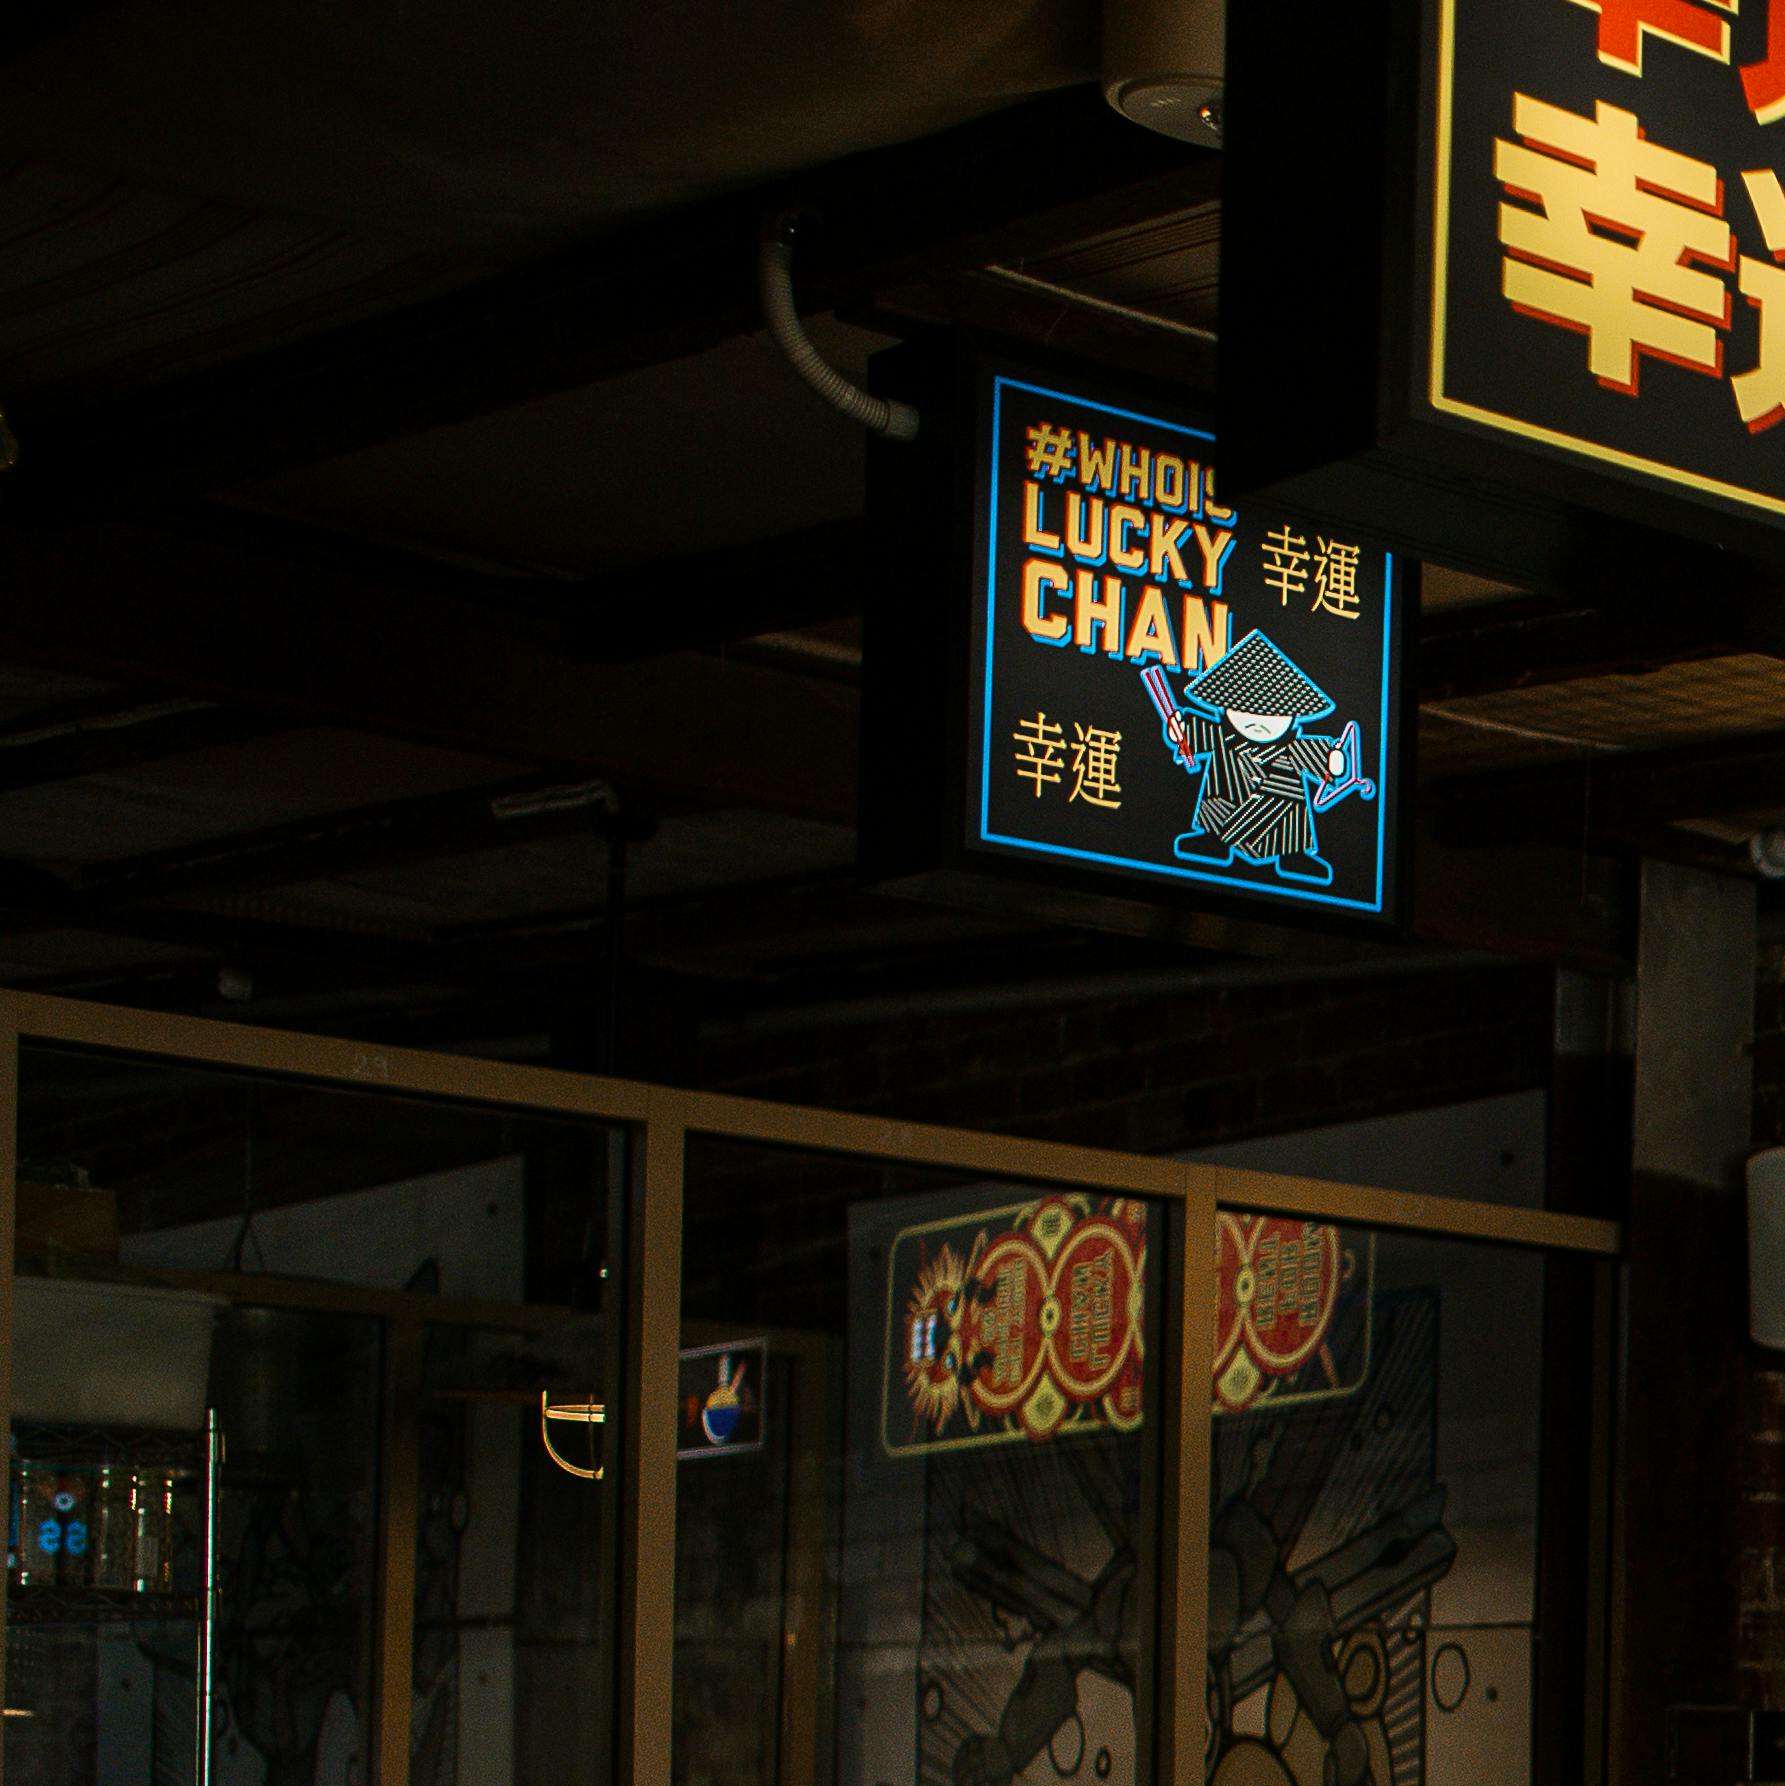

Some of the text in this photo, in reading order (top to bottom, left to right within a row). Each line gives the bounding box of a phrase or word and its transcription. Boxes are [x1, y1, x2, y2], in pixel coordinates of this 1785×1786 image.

[1021, 480, 1237, 594] LUCKY
[1261, 524, 1361, 620] 幸運
[1021, 557, 1233, 678] CHAN
[1012, 711, 1123, 810] 幸運
